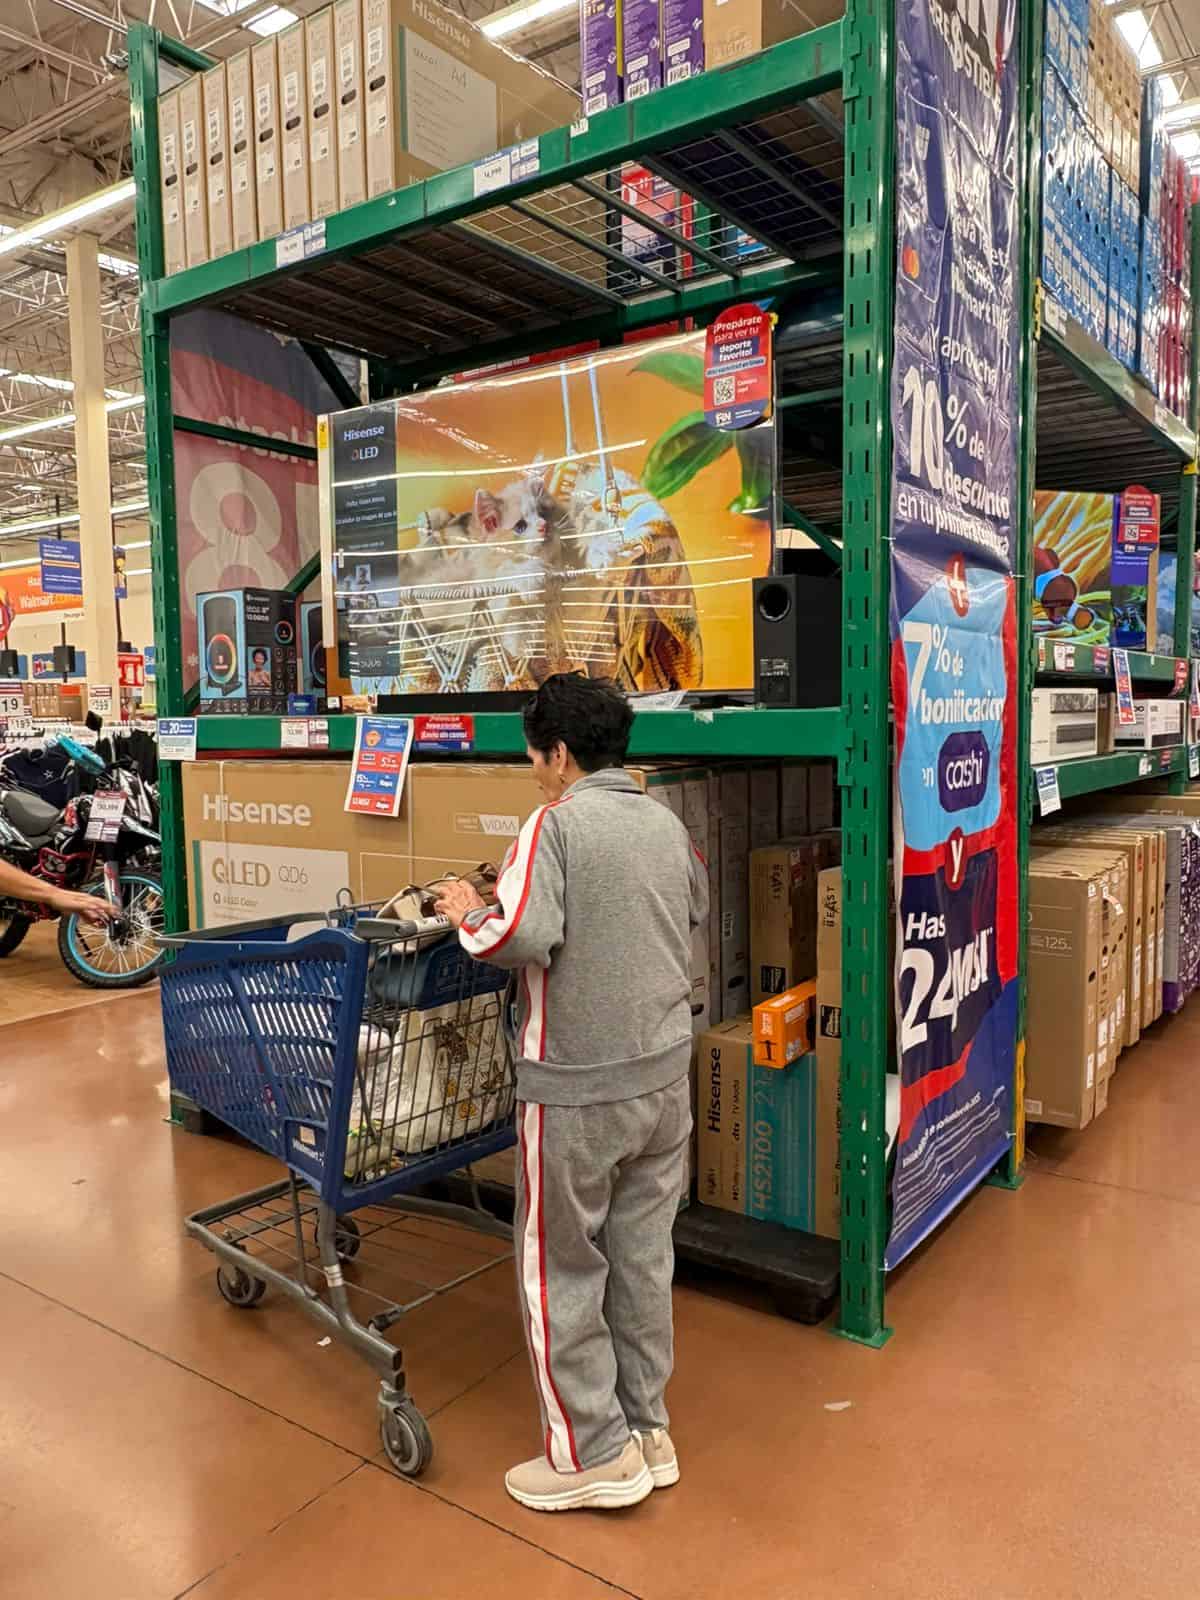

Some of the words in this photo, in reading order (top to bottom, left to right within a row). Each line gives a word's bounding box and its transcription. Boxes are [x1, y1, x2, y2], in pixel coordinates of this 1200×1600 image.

[343, 424, 385, 441] Hisense
[953, 650, 964, 677] de
[945, 751, 984, 791] cashi
[201, 793, 312, 827] Hisense
[211, 857, 271, 888] QLED
[278, 864, 309, 885] QD6
[707, 1047, 722, 1134] Hisense
[753, 1119, 774, 1211] HS2100
